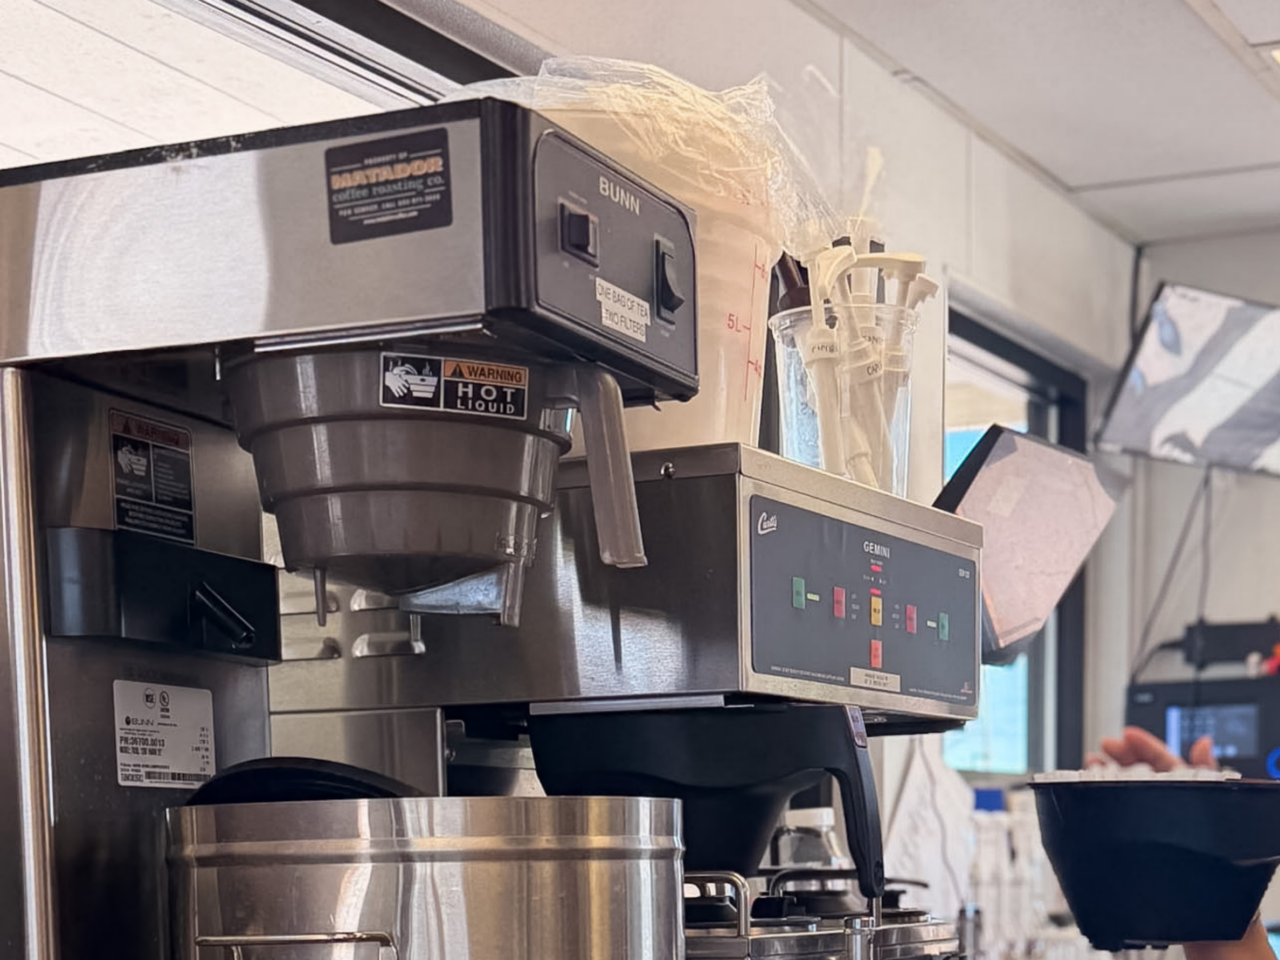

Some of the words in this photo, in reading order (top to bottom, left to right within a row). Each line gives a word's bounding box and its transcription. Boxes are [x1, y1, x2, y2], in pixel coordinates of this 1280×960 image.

[331, 157, 444, 190] MATADOR
[372, 179, 424, 197] roasting
[600, 176, 640, 216] BUNN
[597, 282, 612, 301] ONE
[612, 290, 626, 308] BAG
[626, 297, 636, 311] OF
[636, 302, 649, 320] TEA
[620, 314, 645, 337] FILTERS
[467, 365, 522, 383] WARNING
[457, 382, 516, 402] HOT
[456, 399, 515, 415] LIQUID
[758, 511, 777, 535] Curtis
[863, 541, 890, 559] GEMINI
